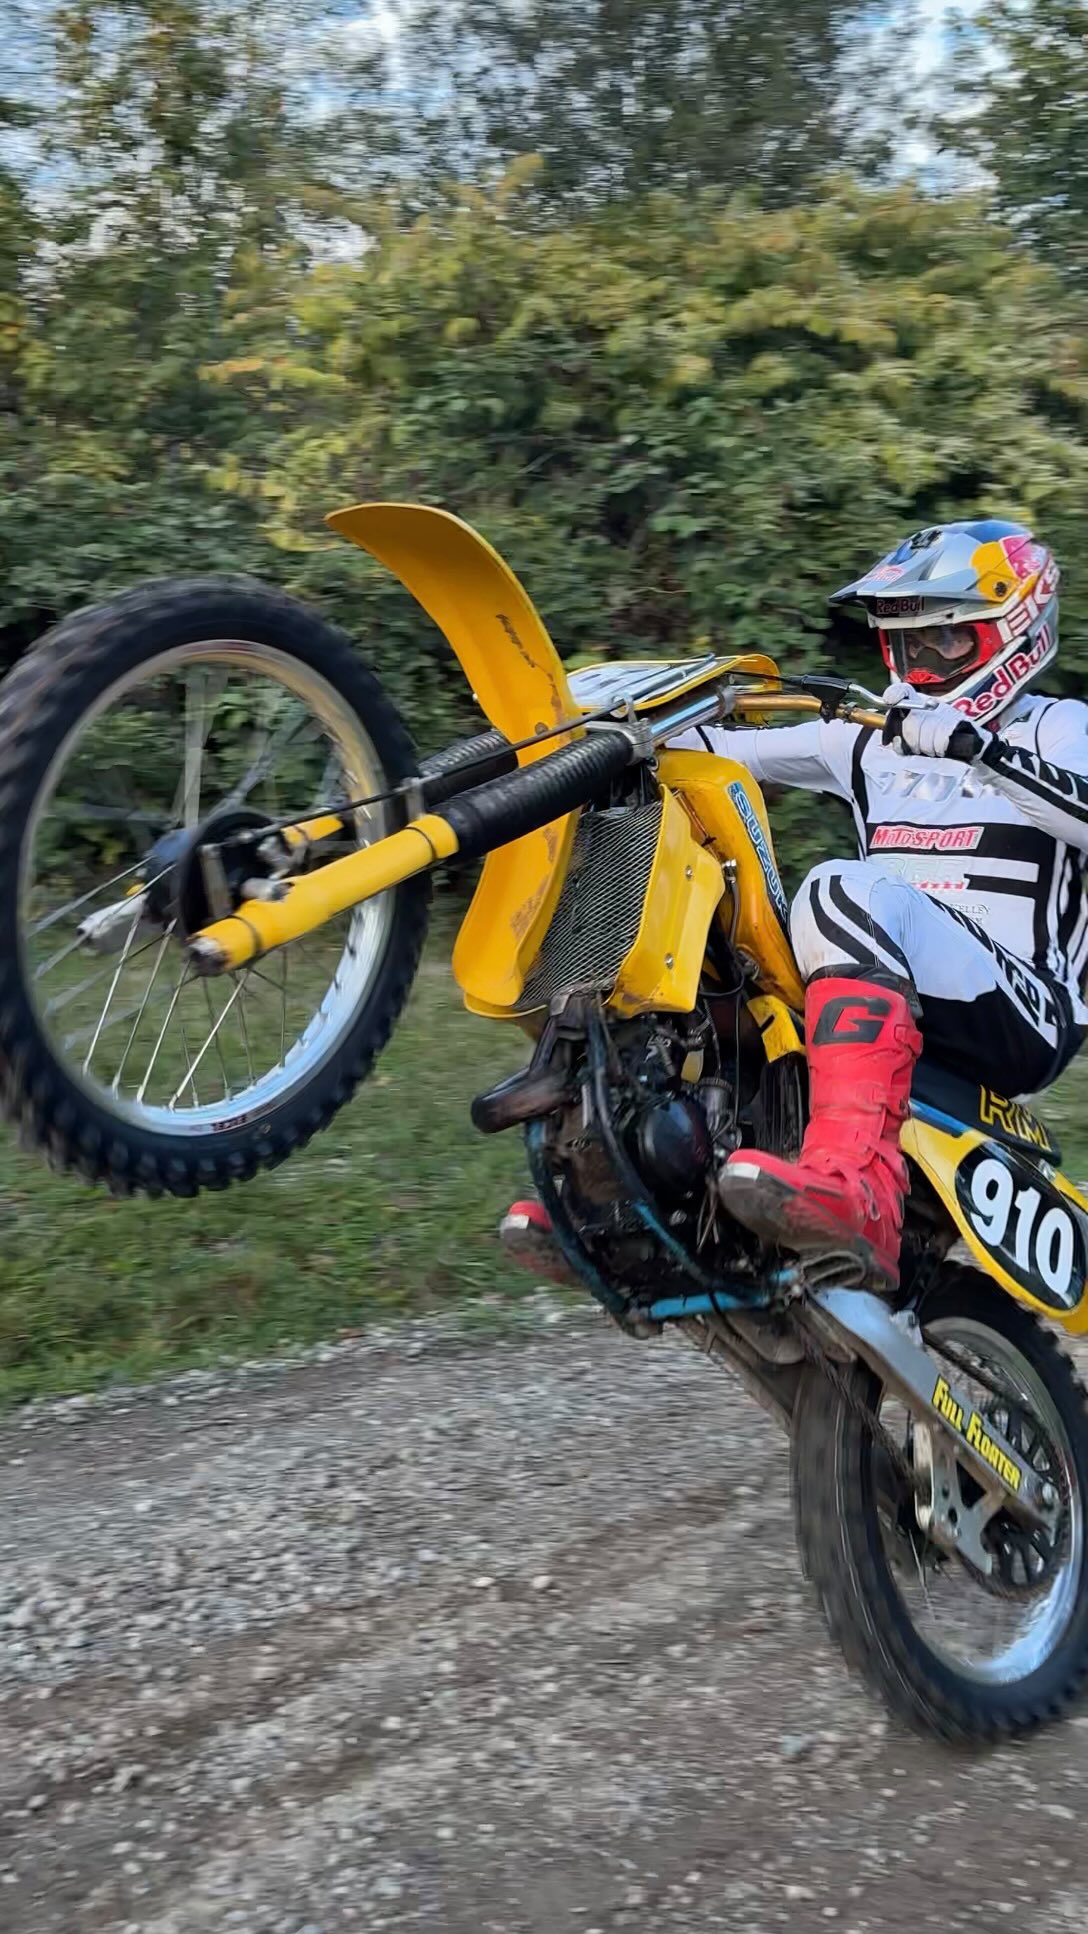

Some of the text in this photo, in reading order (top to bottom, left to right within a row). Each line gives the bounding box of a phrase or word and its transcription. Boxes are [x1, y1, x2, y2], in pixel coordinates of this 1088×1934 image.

[877, 596, 925, 614] Red Bull
[952, 622, 1051, 719] Red Bull
[735, 790, 789, 924] SUZUK
[978, 1084, 1053, 1152] RM
[970, 1158, 1074, 1294] 910
